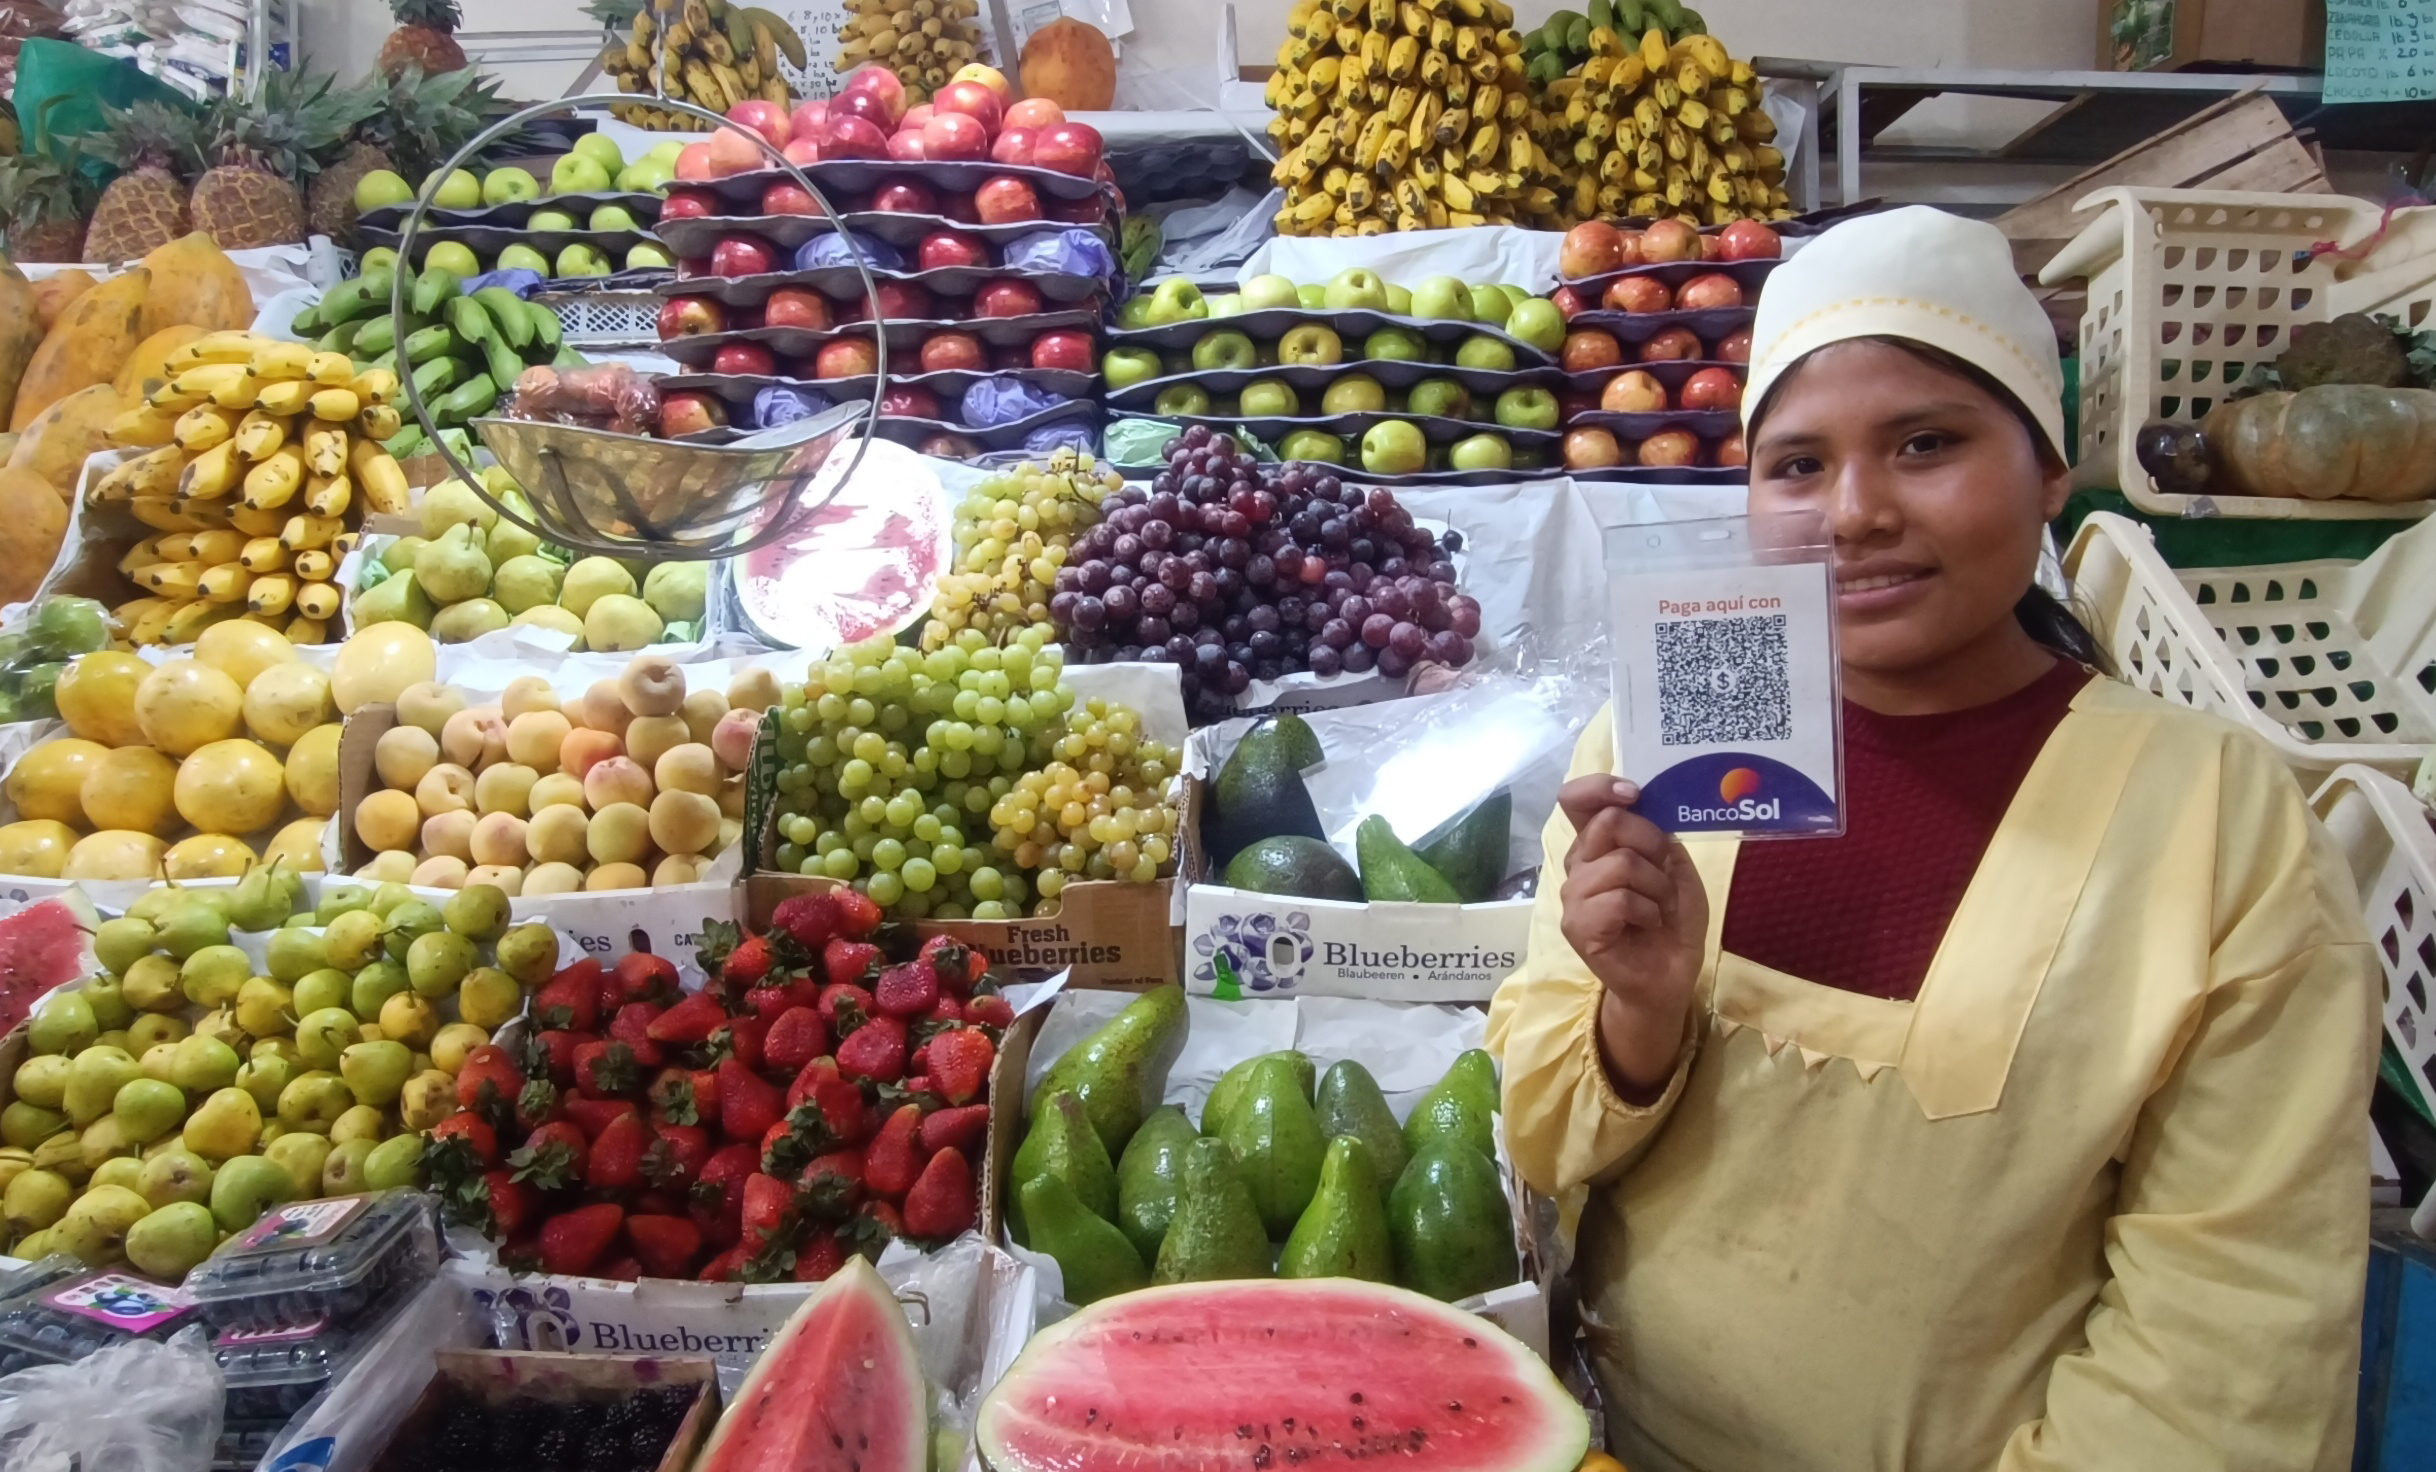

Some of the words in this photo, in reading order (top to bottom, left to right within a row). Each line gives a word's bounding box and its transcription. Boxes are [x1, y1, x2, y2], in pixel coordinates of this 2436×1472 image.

[2397, 47, 2418, 59] 20
[2405, 86, 2419, 99] 10
[1659, 599, 1701, 617] Paga
[1706, 595, 1744, 614] aquí
[1748, 597, 1781, 609] con
[1678, 798, 1780, 822] BancoSol
[674, 933, 693, 946] CA
[1006, 924, 1070, 943] Fresh
[966, 941, 1122, 965] lueberries
[1323, 942, 1515, 968] Blueberries
[1338, 968, 1405, 980] Blaubeeren
[1428, 970, 1492, 981] Arándanos
[589, 1321, 769, 1353] Blueberr
